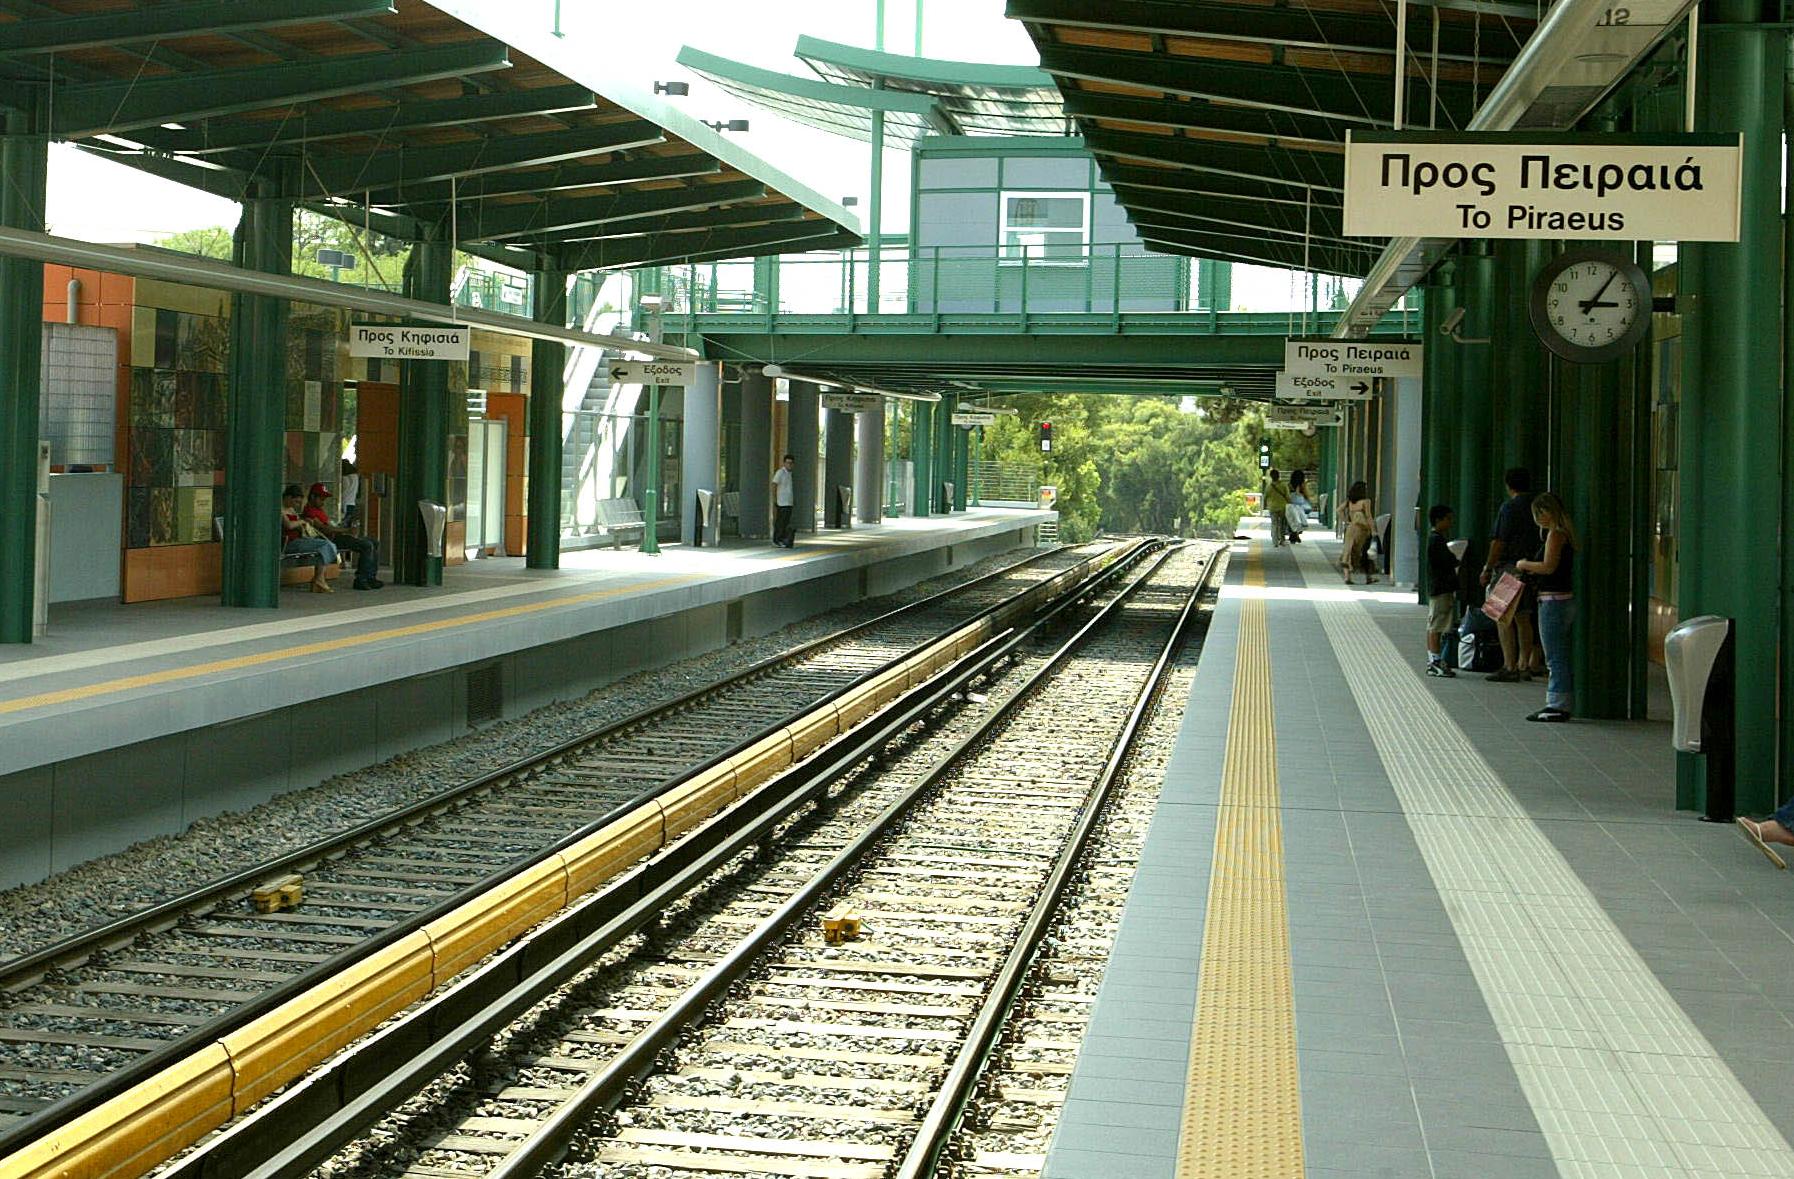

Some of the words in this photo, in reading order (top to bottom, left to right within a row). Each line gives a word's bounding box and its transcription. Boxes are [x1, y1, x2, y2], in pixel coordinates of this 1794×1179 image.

[1381, 153, 1496, 196] Προς
[1520, 154, 1703, 197] Πειραιά
[1456, 204, 1491, 229] To
[1507, 204, 1625, 231] Piraeus
[1570, 271, 1578, 280] 11
[1587, 266, 1598, 275] 12
[1558, 283, 1568, 293] 10
[1621, 282, 1628, 292] 2
[1552, 299, 1559, 308] 9
[1627, 299, 1633, 309] 3
[1558, 316, 1565, 326] 8
[1620, 317, 1627, 325] 4
[359, 329, 394, 344] Προς
[401, 330, 459, 345] Κηφισιά
[1571, 328, 1577, 338] 7
[1588, 332, 1595, 342] 6
[1607, 328, 1613, 338] 5
[384, 346, 394, 355] To
[398, 347, 434, 357] Kifissia
[1298, 346, 1339, 361] Προς
[1347, 347, 1410, 362] Πειραιά
[1324, 363, 1337, 373] To
[1342, 364, 1383, 374] Piraeus
[1291, 377, 1335, 389] Έξοδος
